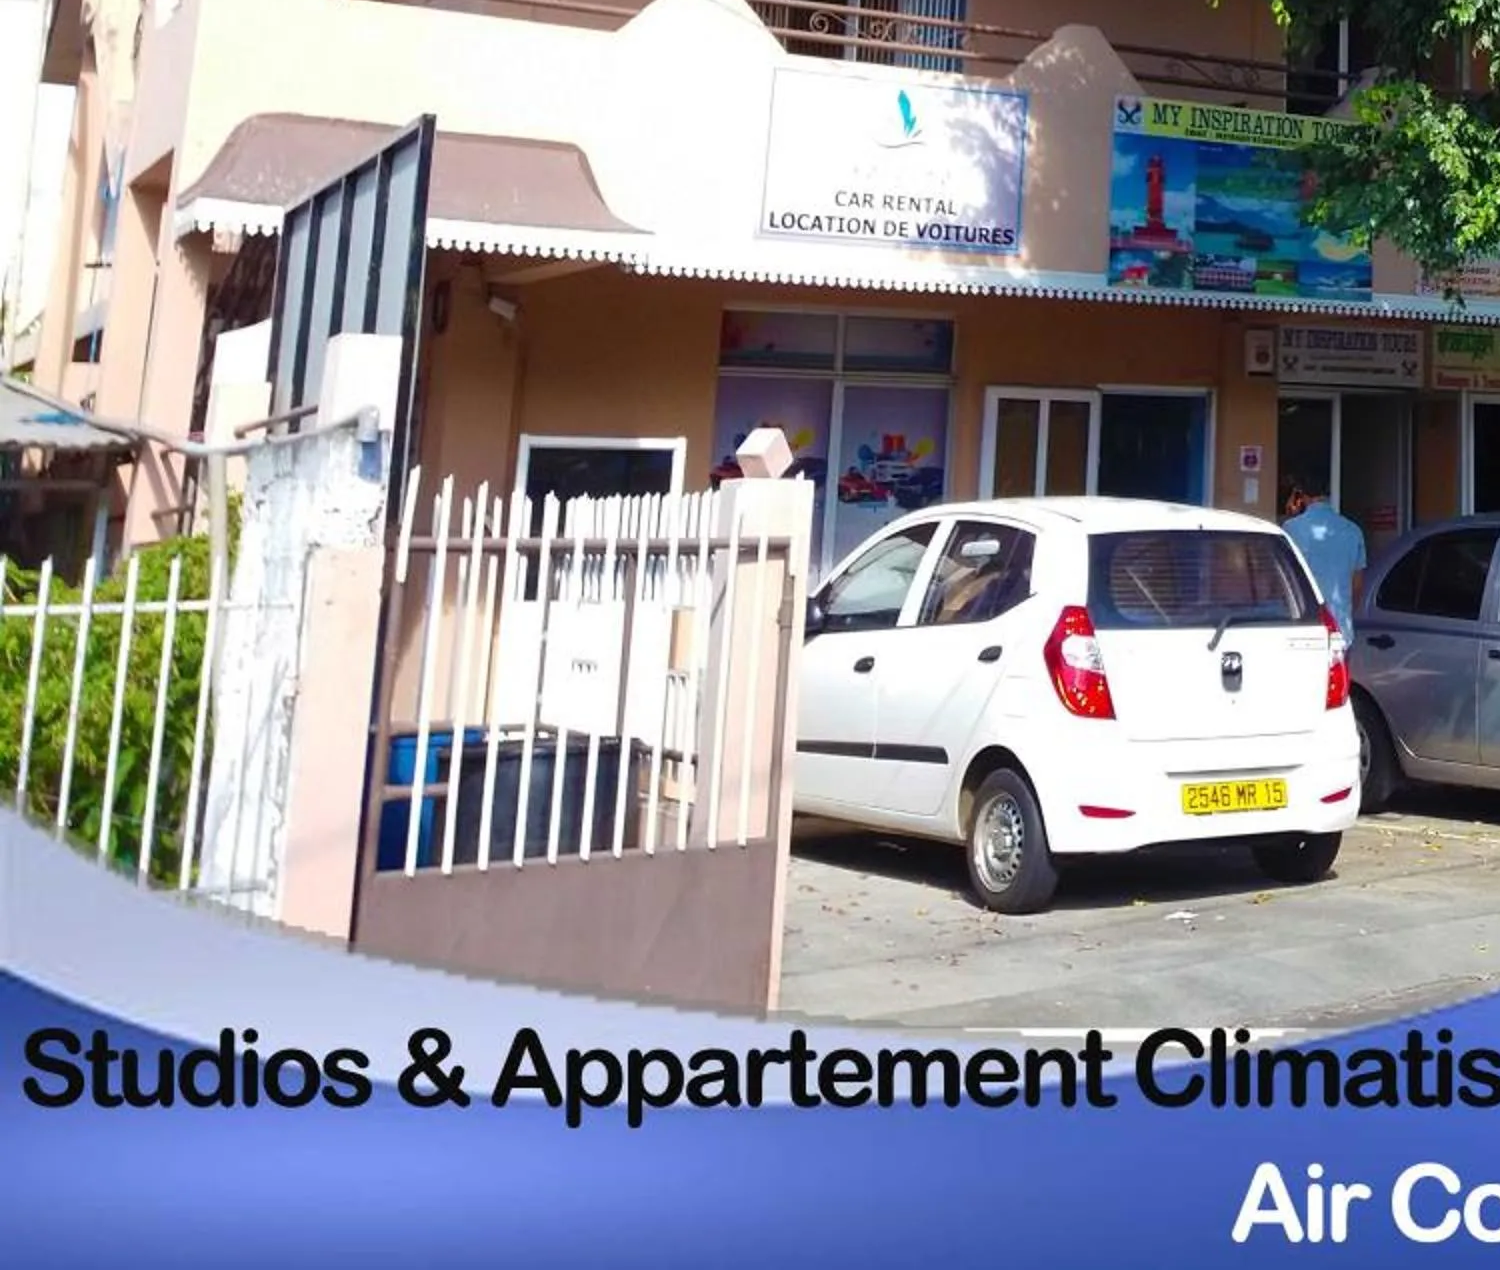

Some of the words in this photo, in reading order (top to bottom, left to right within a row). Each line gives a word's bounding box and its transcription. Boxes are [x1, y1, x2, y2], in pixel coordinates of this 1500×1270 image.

[1153, 103, 1182, 127] MY
[1190, 106, 1303, 140] INSPIRATION
[1312, 121, 1366, 146] TOU
[834, 190, 875, 209] CAR
[882, 194, 957, 216] RENTAL
[769, 211, 876, 236] LOCATION
[883, 219, 909, 239] DE
[915, 223, 1016, 246] VOITURES
[1187, 784, 1231, 809] 2546
[1236, 782, 1257, 806] MR
[1265, 781, 1283, 804] 15
